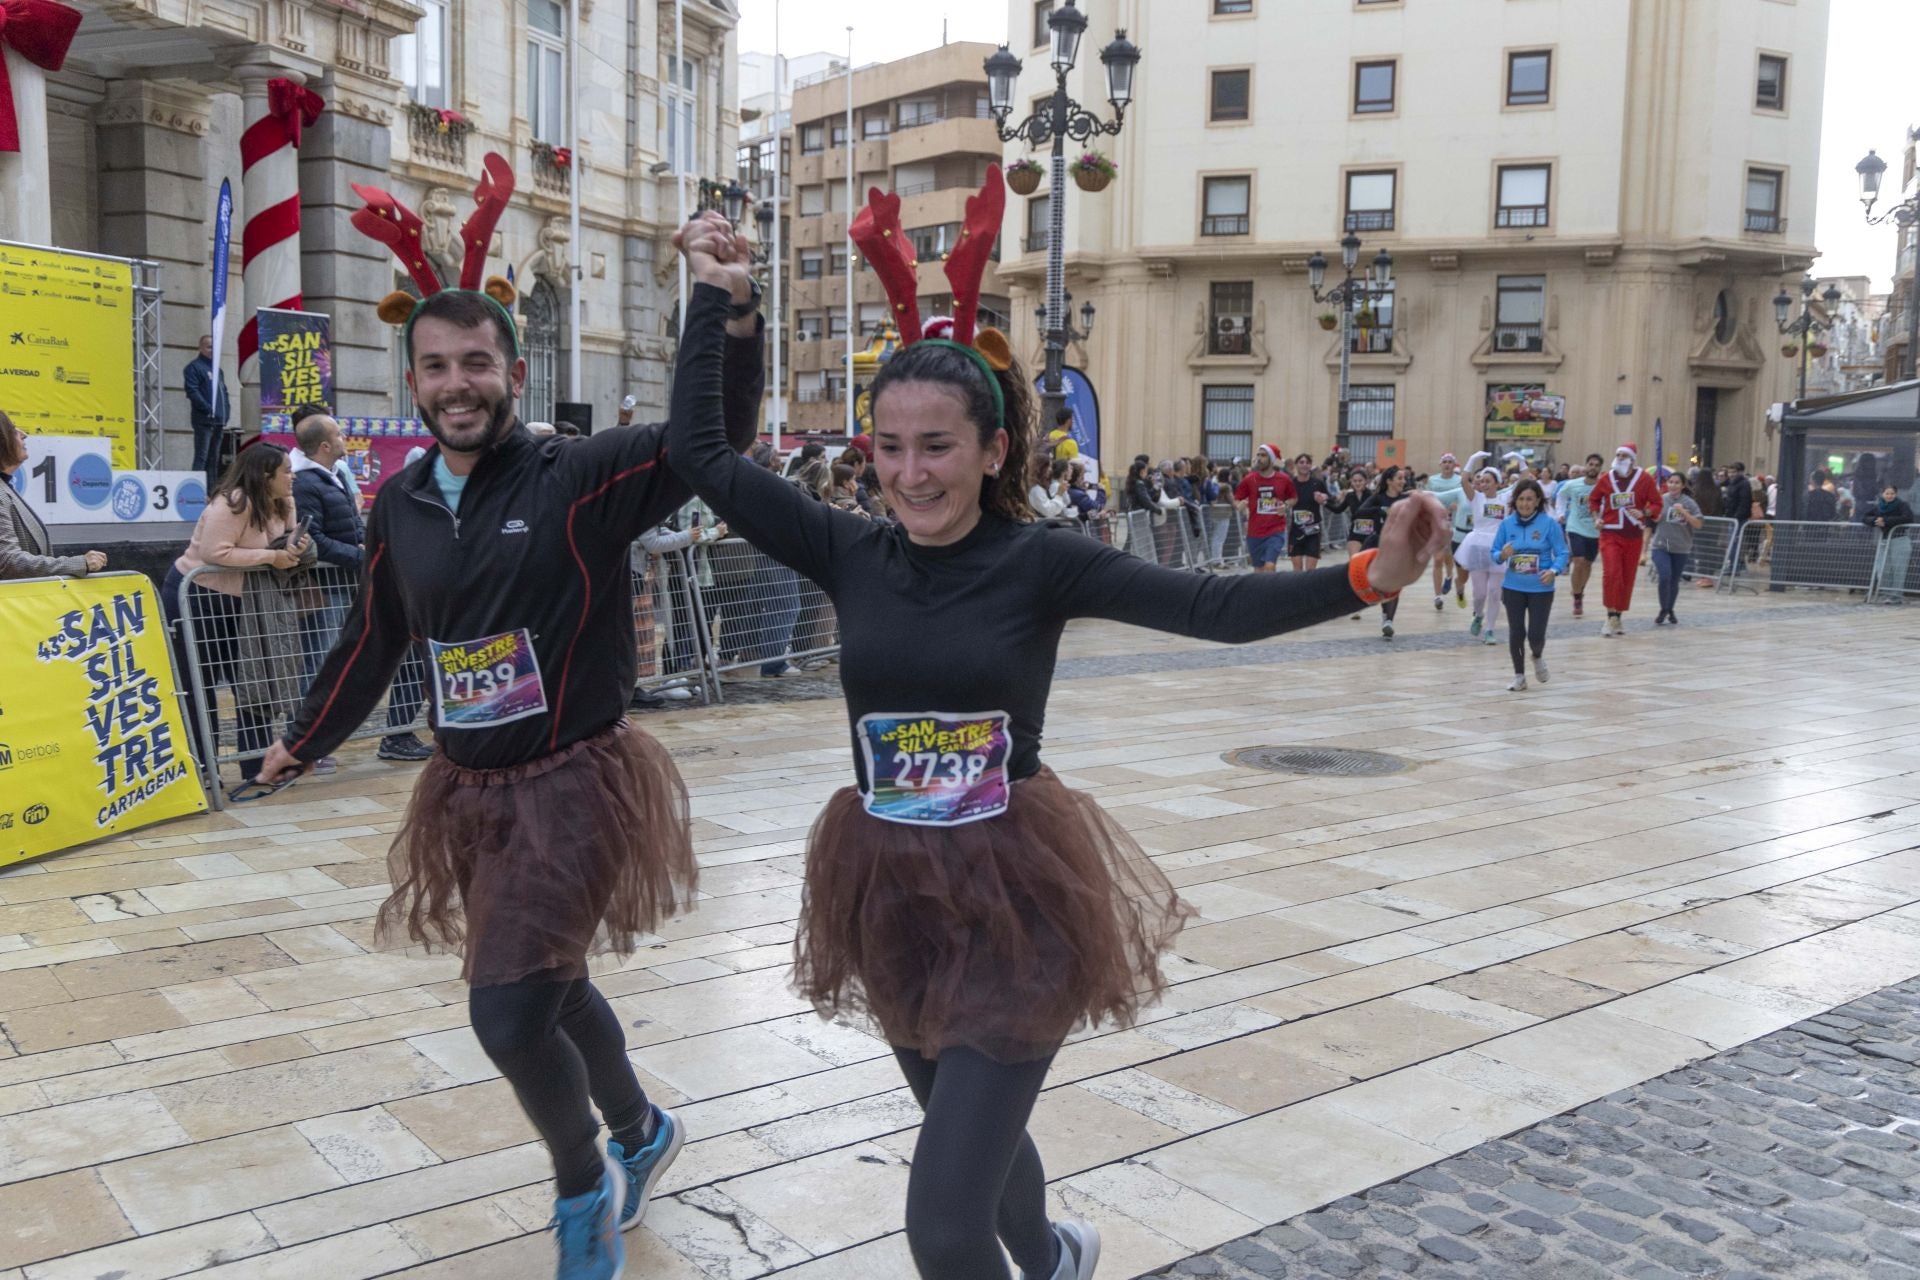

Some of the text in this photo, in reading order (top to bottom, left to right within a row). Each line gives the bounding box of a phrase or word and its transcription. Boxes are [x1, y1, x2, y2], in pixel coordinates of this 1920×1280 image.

[27, 333, 69, 346] CaixaBank
[277, 331, 322, 353] SAN
[284, 349, 317, 370] SIL
[10, 368, 40, 377] VERDAD
[281, 366, 321, 388] VES
[282, 384, 323, 405] TRE
[32, 455, 57, 503] 1
[82, 480, 109, 488] Deportes
[152, 485, 169, 510] 3
[56, 590, 147, 659] SAN
[441, 646, 465, 663] SAN
[443, 633, 515, 674] SILVESTRE
[82, 639, 147, 702] SIL
[445, 662, 516, 701] 2739
[82, 676, 162, 748] VES
[896, 719, 936, 737] SAN
[93, 721, 175, 795] TRE
[892, 751, 988, 789] 2738
[96, 761, 188, 825] CARTAGENA
